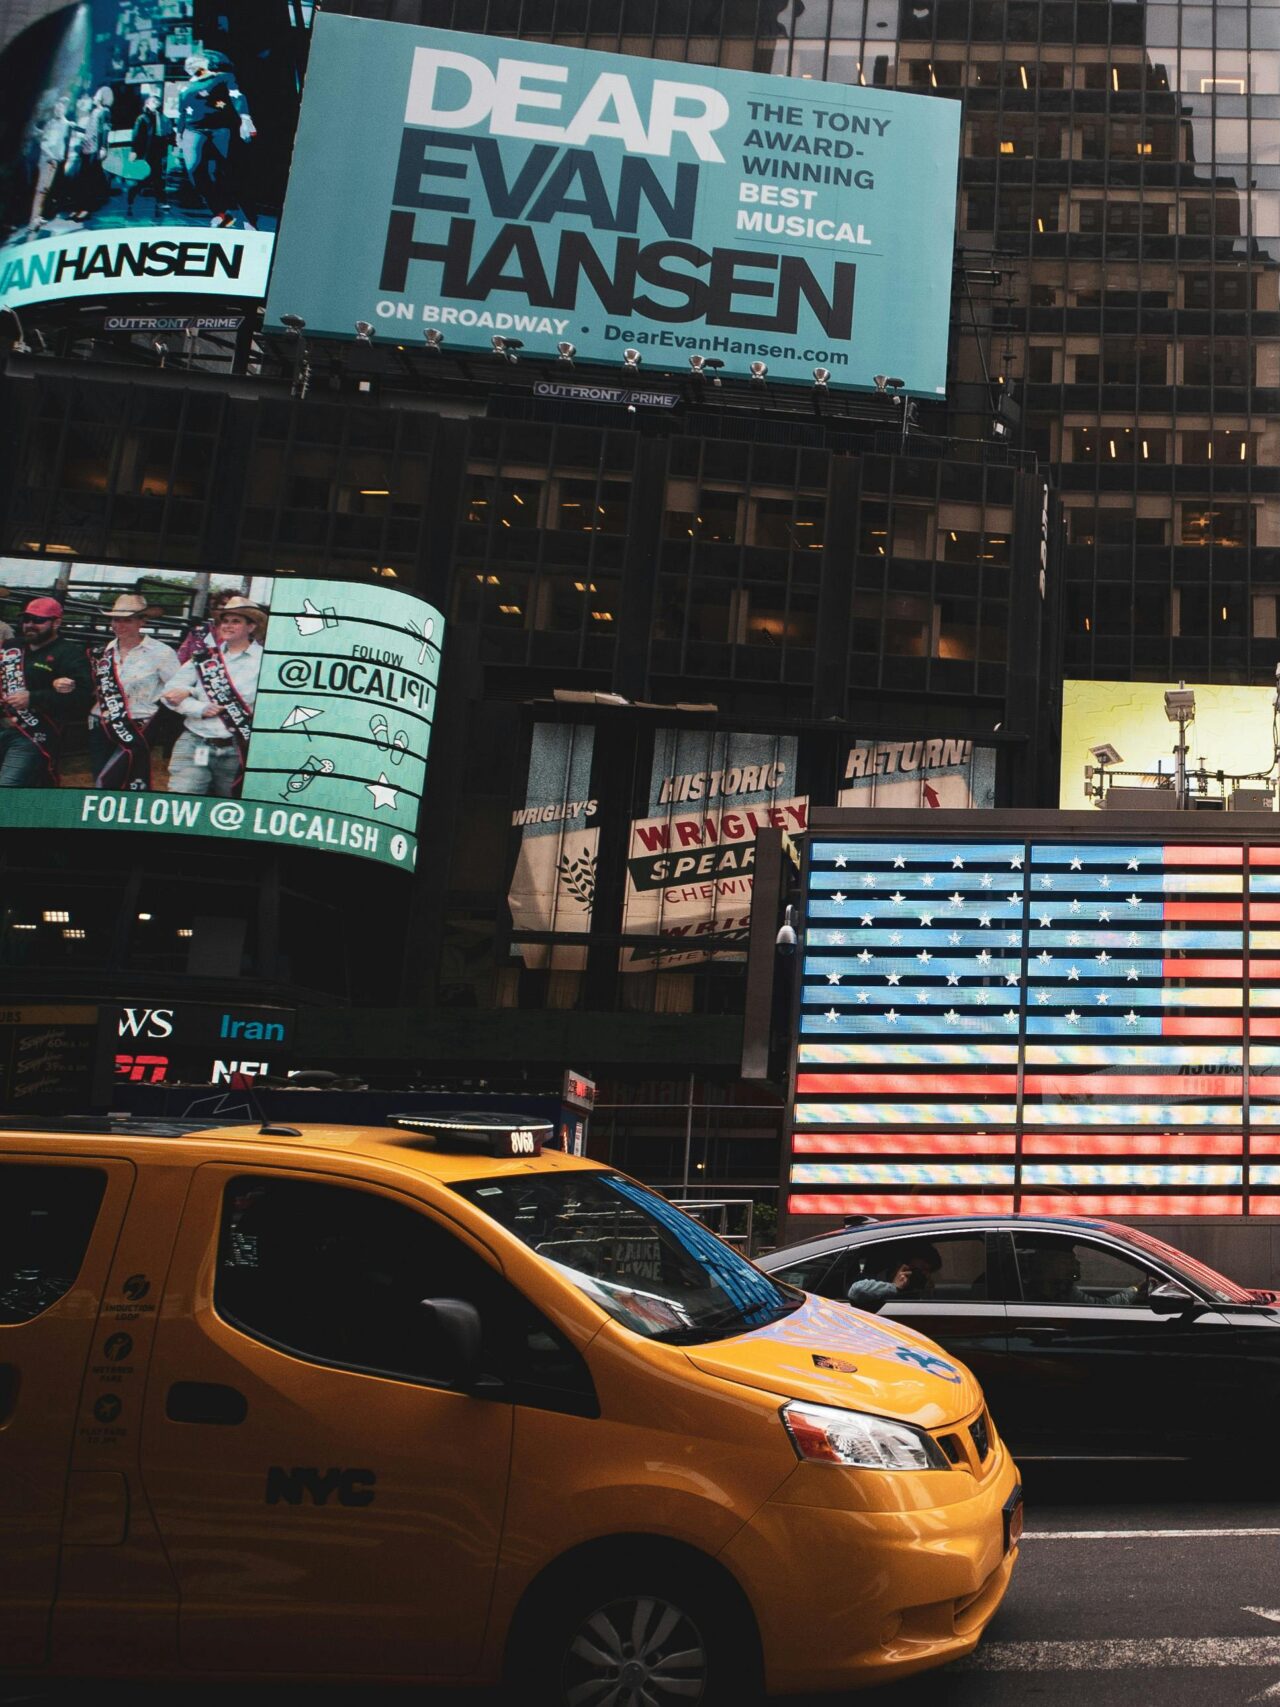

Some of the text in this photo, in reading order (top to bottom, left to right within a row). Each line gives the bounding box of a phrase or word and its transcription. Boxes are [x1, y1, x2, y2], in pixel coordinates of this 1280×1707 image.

[404, 47, 729, 163] DEAR
[746, 101, 892, 137] THE TONY
[743, 129, 865, 159] AWARD-
[393, 127, 700, 239] EVAN
[741, 155, 875, 190] WINNING
[738, 181, 818, 210] BEST
[736, 210, 872, 244] MUSICAL
[379, 211, 857, 340] HANSEN
[108, 317, 238, 329] OUTFRONT PRIME
[375, 300, 850, 366] ON BROADWAY DearEvanHansen.com
[538, 383, 674, 406] OUTFRONT PRIME
[352, 644, 404, 667] FOLLOW
[18, 708, 39, 728] 2019
[112, 721, 134, 743] 2019
[844, 738, 973, 779] RETURN!
[660, 761, 786, 804] HISTORIC
[82, 794, 380, 853] FOLLOW @ LOCALISH
[512, 799, 599, 827] WRIGLEY'S
[220, 1013, 285, 1041] Iran
[511, 1131, 534, 1154] 8V68
[105, 1303, 155, 1312] INDUCTION
[115, 1312, 140, 1321] LOOP
[266, 1466, 376, 1506] NYC
